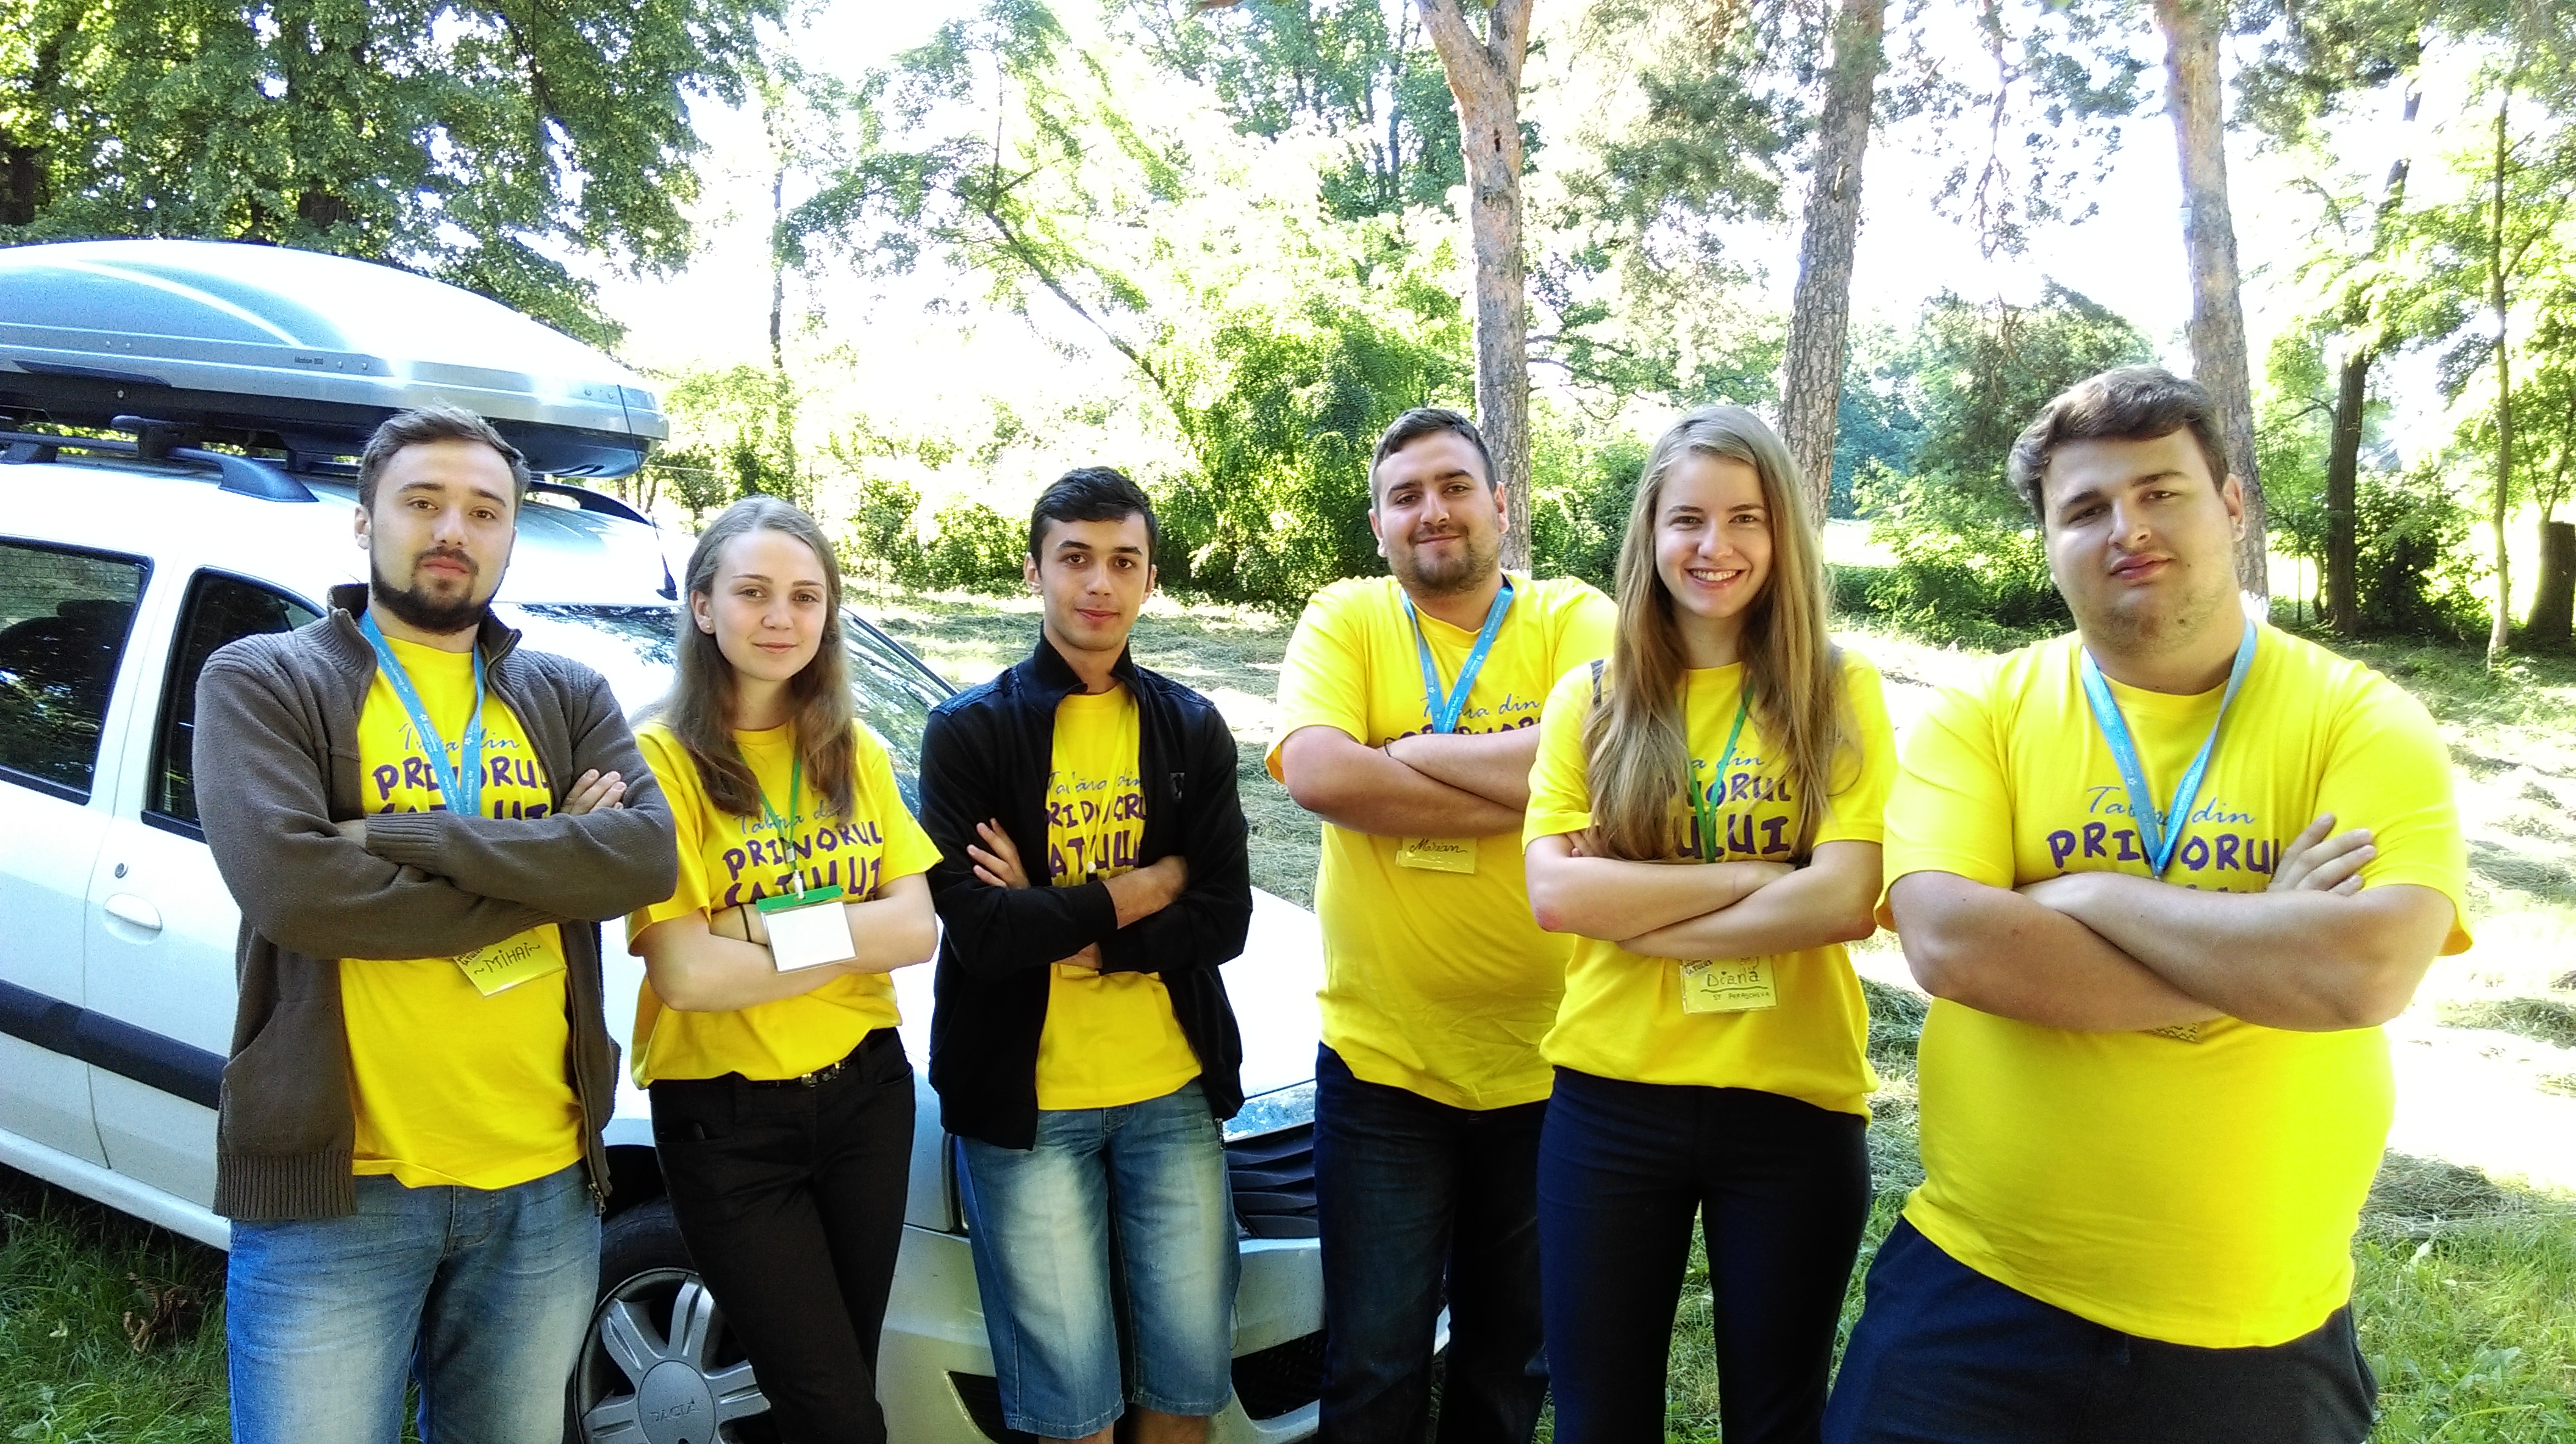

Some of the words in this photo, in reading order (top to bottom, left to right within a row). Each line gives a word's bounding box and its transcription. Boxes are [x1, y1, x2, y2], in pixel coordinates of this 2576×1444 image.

[1498, 693, 1540, 715] din
[2191, 797, 2256, 825] din
[1707, 971, 1761, 987] Diana
